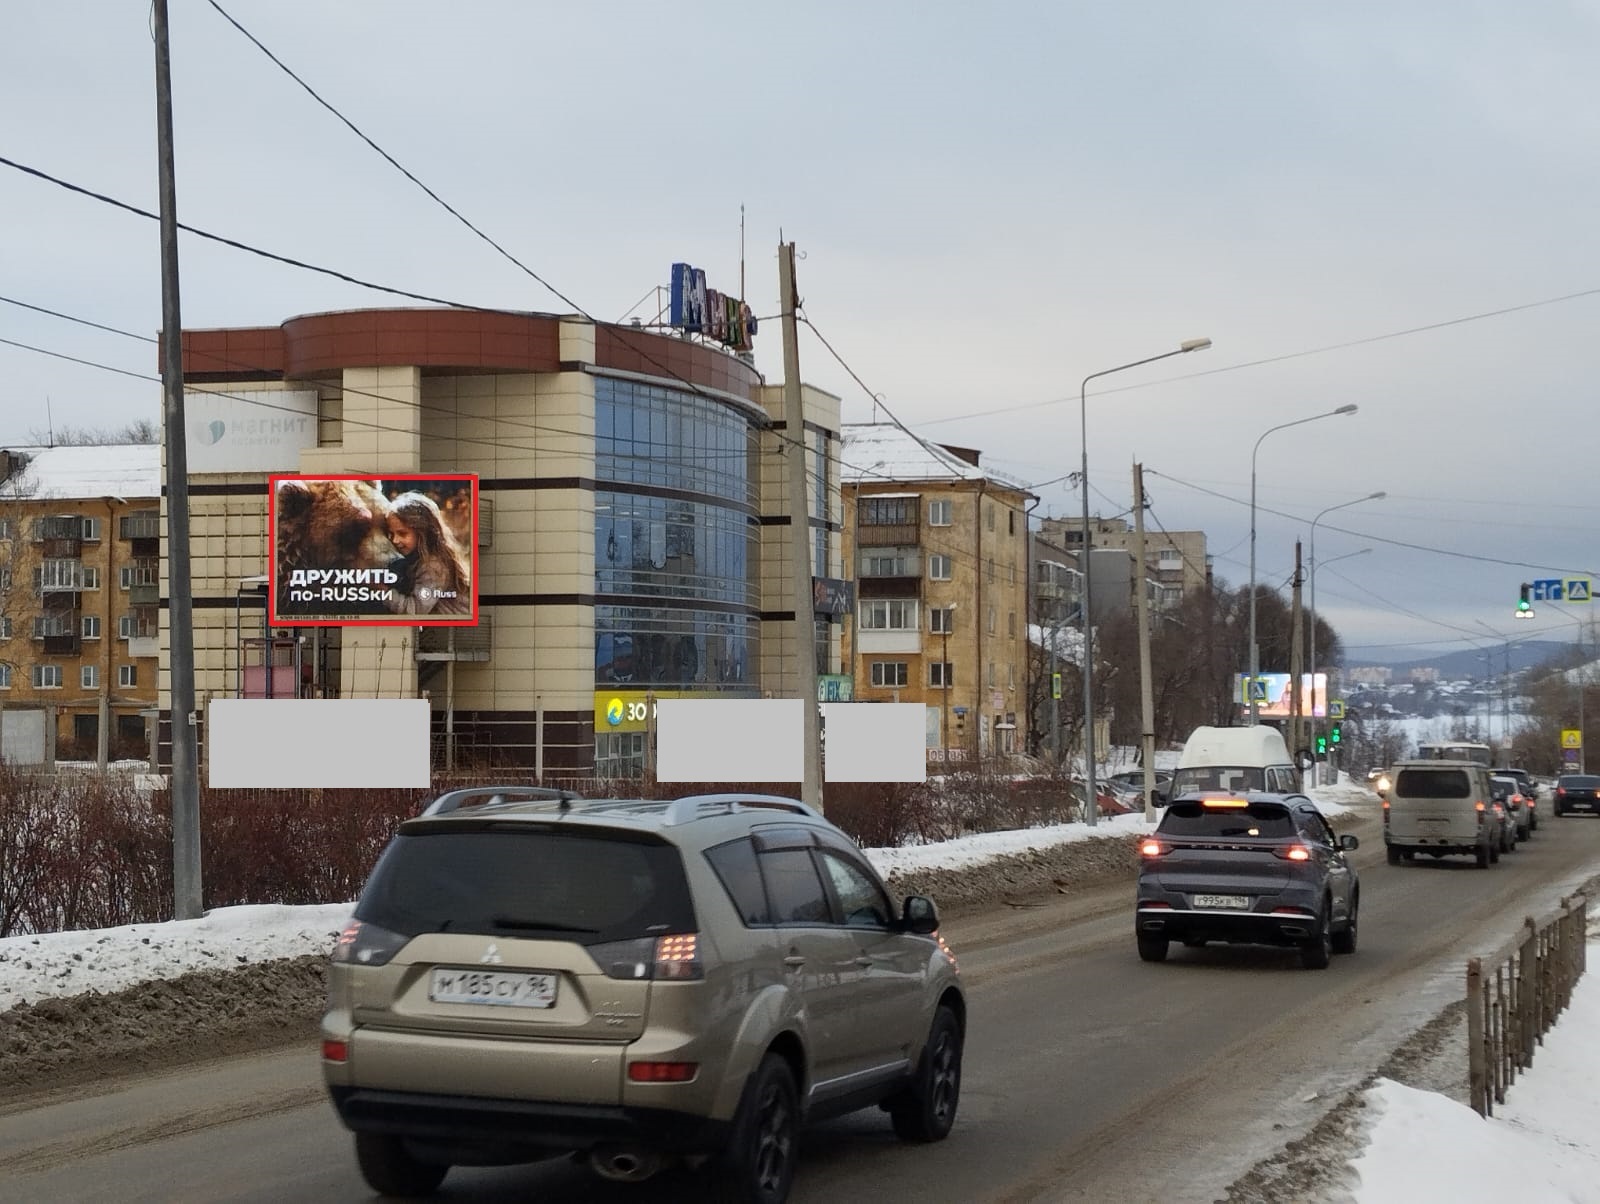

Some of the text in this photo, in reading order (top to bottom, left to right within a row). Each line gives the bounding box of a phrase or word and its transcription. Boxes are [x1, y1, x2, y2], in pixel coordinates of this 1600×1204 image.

[289, 568, 398, 587] ДРУЖИТЬ
[290, 587, 393, 602] по-RUSSки
[433, 589, 457, 598] Russ
